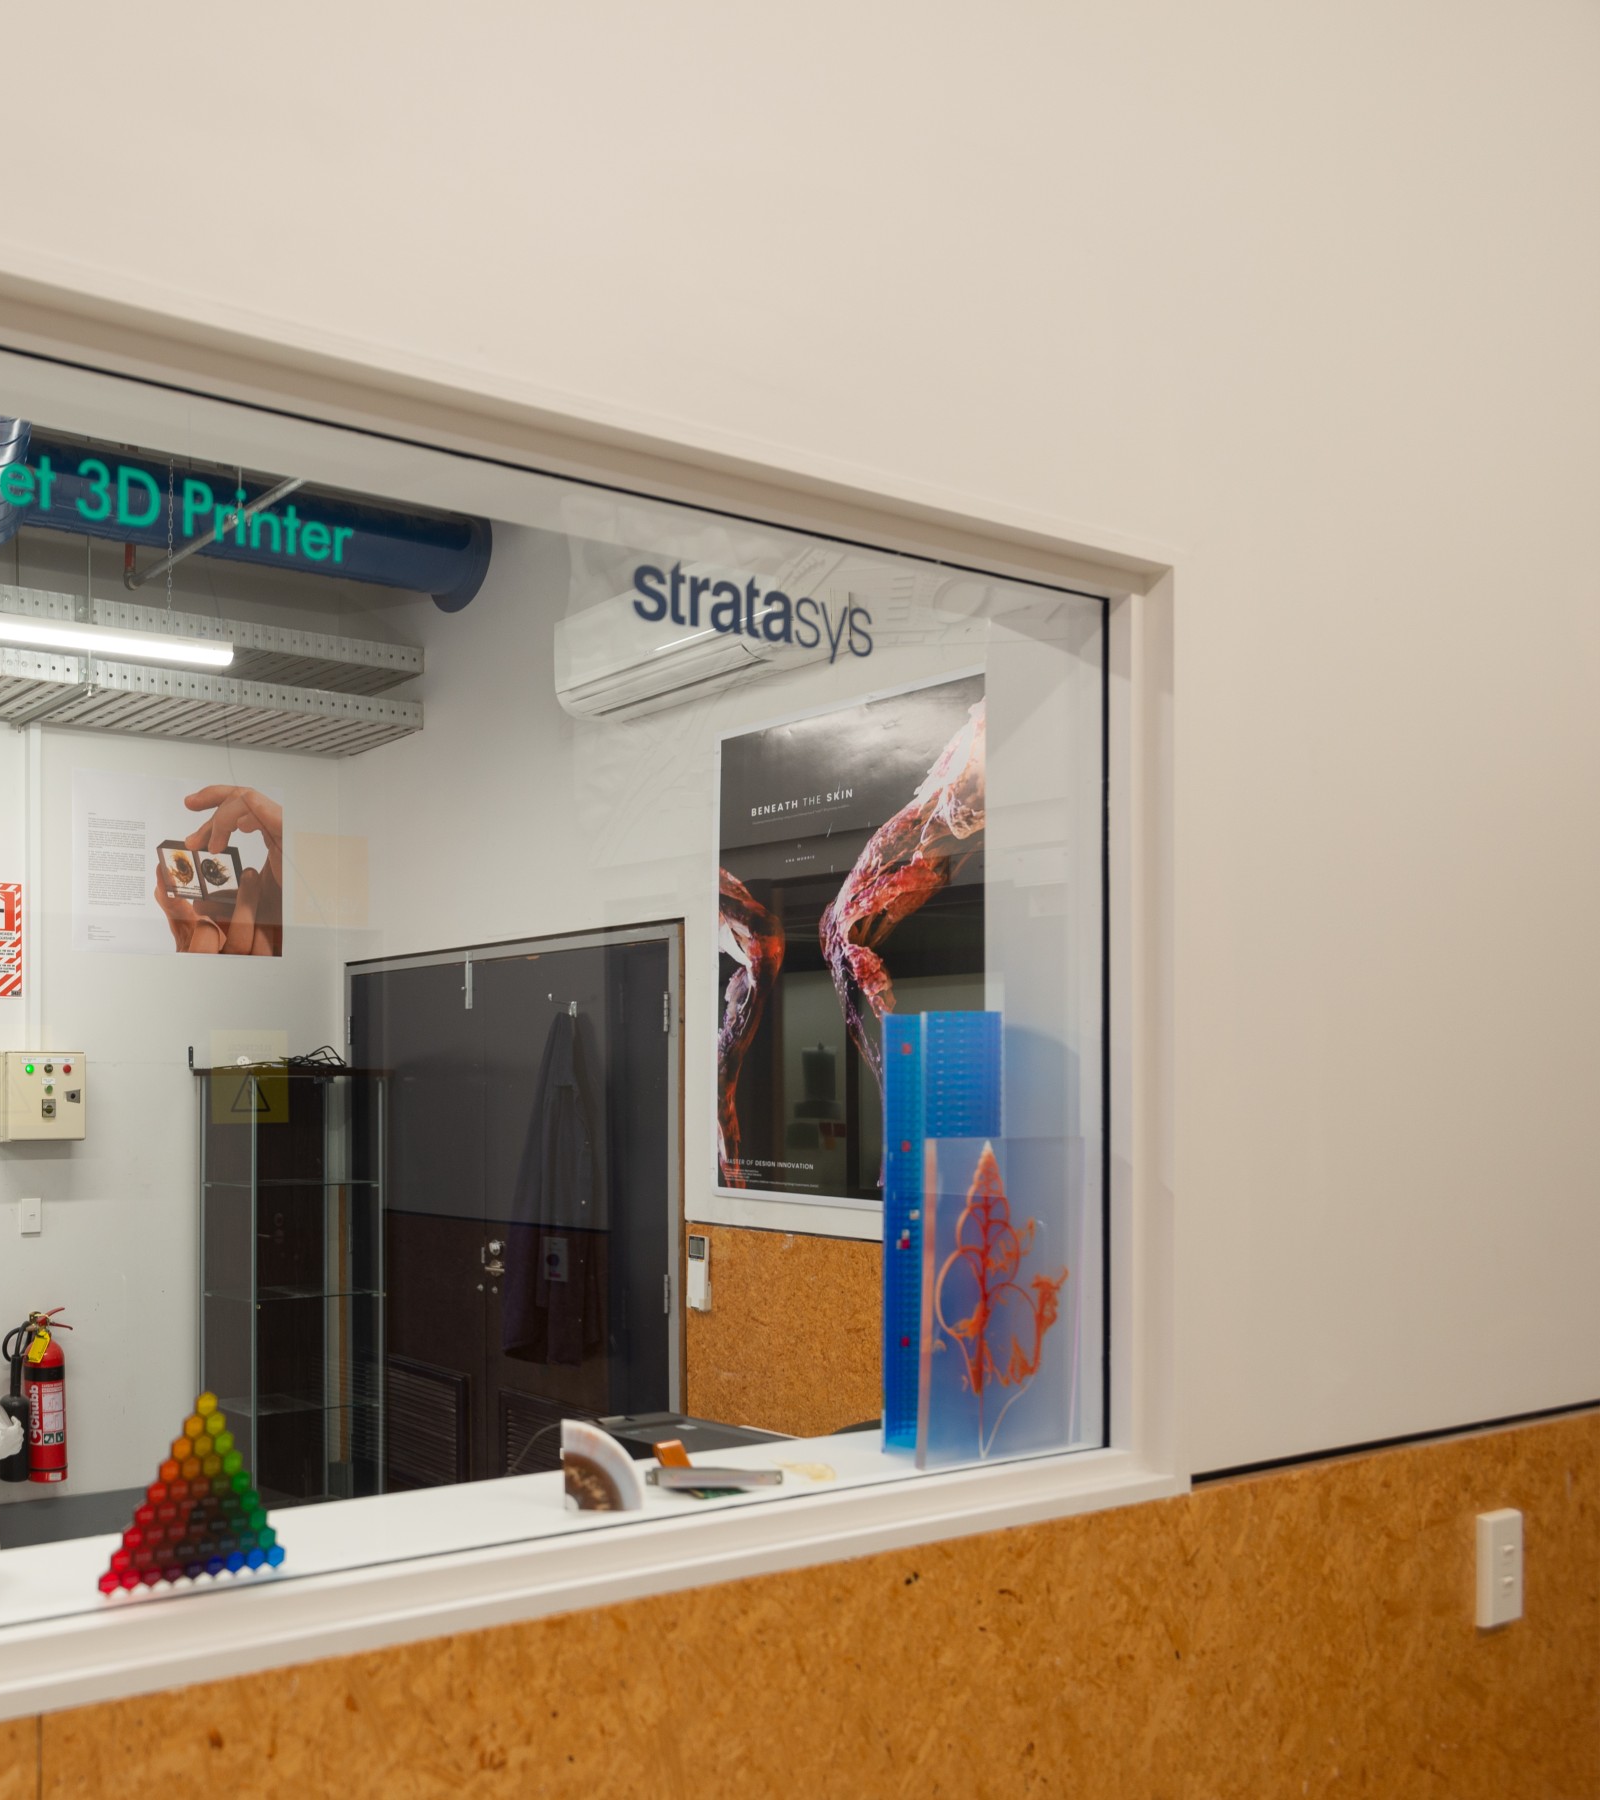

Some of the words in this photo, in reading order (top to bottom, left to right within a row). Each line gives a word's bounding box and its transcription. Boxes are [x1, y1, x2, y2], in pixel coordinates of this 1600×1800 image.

[77, 458, 160, 527] 3D
[182, 480, 353, 563] Printer
[631, 561, 874, 664] stratasys
[751, 800, 798, 817] BENEATH
[803, 795, 821, 806] THE
[826, 789, 853, 802] SKIN
[777, 1161, 814, 1170] INNOVATION
[29, 1384, 40, 1430] Chubb
